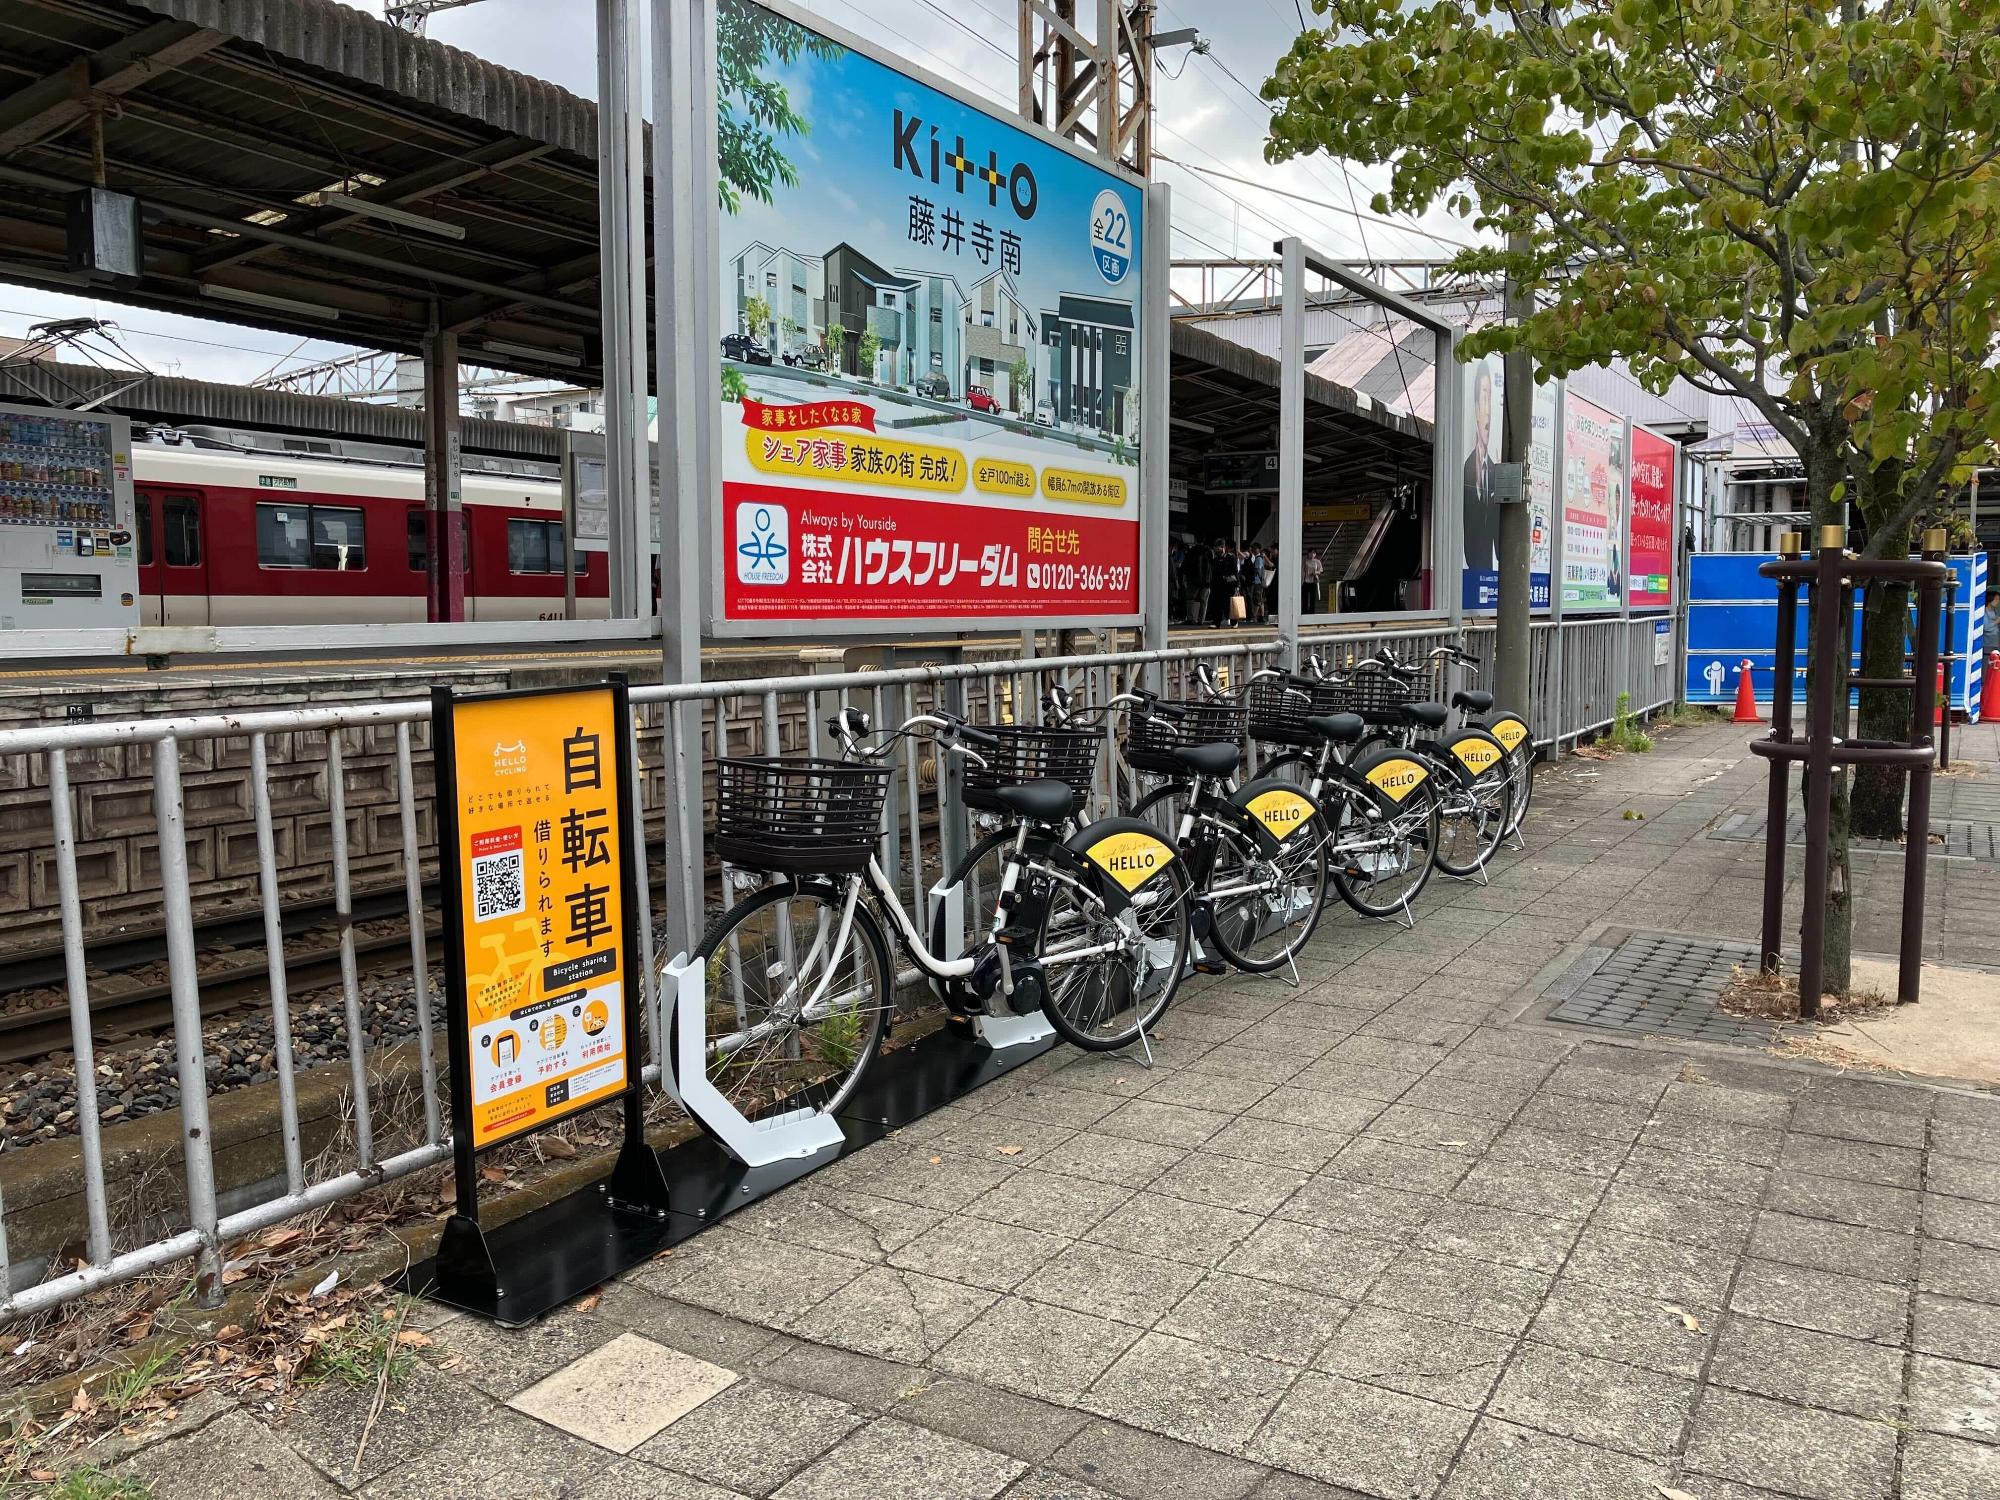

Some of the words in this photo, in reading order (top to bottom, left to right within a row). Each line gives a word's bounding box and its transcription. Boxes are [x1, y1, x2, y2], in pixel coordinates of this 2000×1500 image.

[907, 194, 1022, 276] 藤井寺南
[1102, 255, 1120, 276] 区画
[761, 407, 862, 427] 家事をしたくなる家
[763, 435, 848, 471] シェア家事
[850, 446, 915, 479] 家族の街
[1267, 457, 1276, 468] 4
[800, 509, 838, 531] Always
[841, 512, 854, 532] by
[856, 514, 897, 531] Yourside
[802, 533, 833, 558] 株式
[1027, 526, 1080, 555] 問合せ先
[836, 535, 1018, 587] ハウスフリーダム
[743, 571, 761, 581] HOUSE
[761, 571, 784, 581] FREEDOM
[802, 560, 833, 584] 会社
[1042, 563, 1132, 591] 0120-366-337
[1500, 731, 1520, 741] HELLO
[494, 756, 527, 767] HELLO
[1464, 753, 1491, 762] HELLO
[495, 766, 527, 776] CYCLING
[1382, 773, 1415, 789] HELLO
[468, 783, 550, 803] どこでも借りられて
[468, 795, 550, 815] 好きな場所で返せる
[1264, 808, 1300, 823] HELLO
[560, 726, 613, 948] 自転車
[1109, 854, 1155, 872] HELLO
[533, 819, 555, 958] 借りられます
[553, 963, 579, 977] Bicycle
[582, 954, 608, 968] sharing
[568, 968, 594, 981] station
[537, 1058, 568, 1076] 予約する
[489, 1074, 523, 1094] 会員登録
